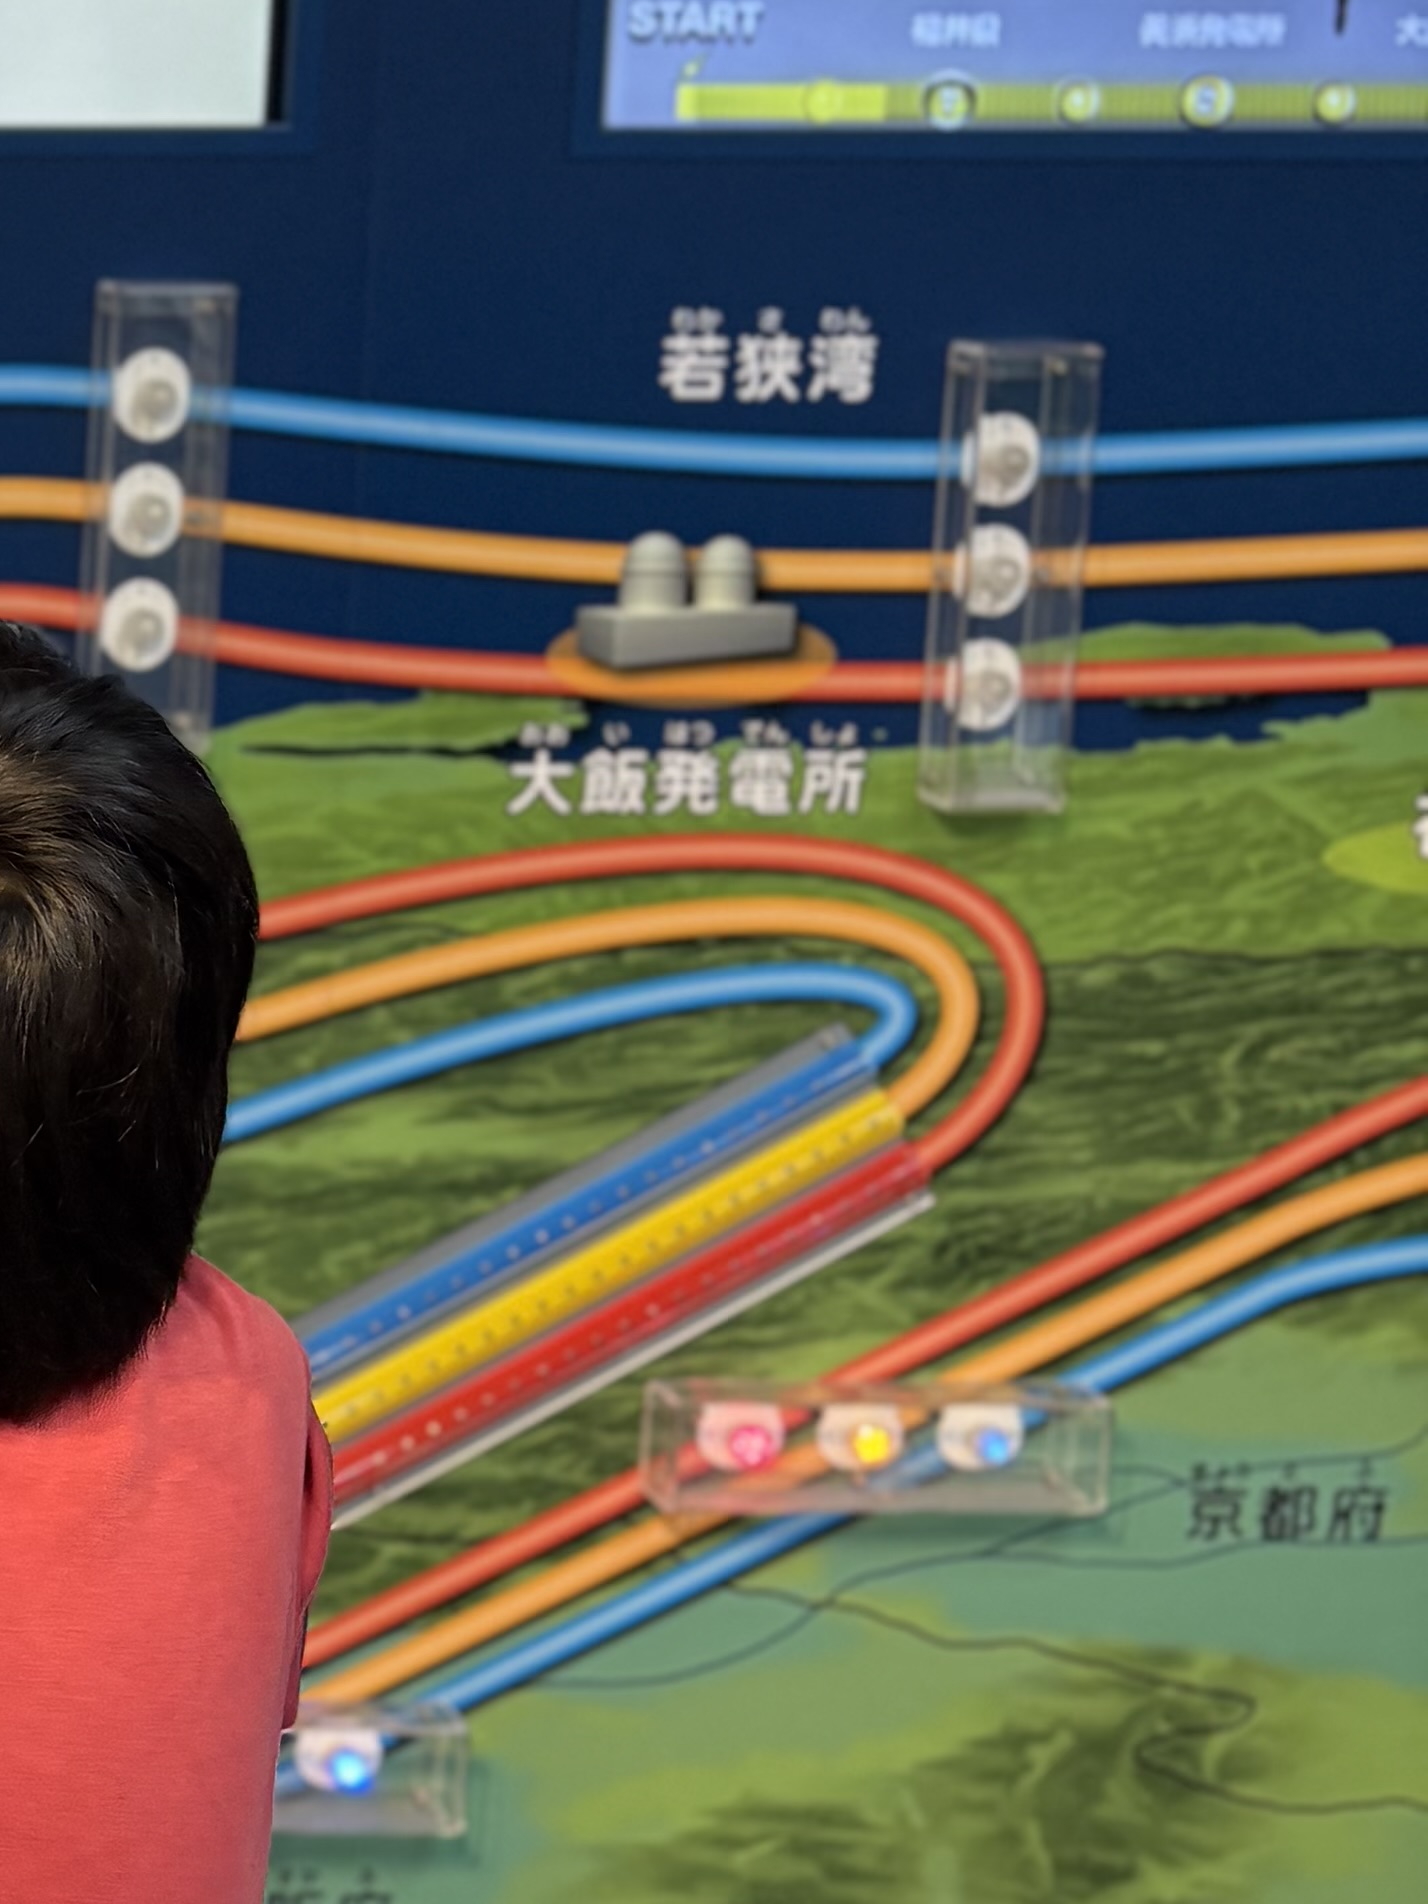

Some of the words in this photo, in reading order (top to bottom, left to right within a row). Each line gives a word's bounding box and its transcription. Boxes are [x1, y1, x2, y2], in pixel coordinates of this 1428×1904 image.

[658, 332, 879, 404] 若狭湾
[505, 748, 869, 817] 大飯発電所
[1185, 1485, 1391, 1542] 京都府
